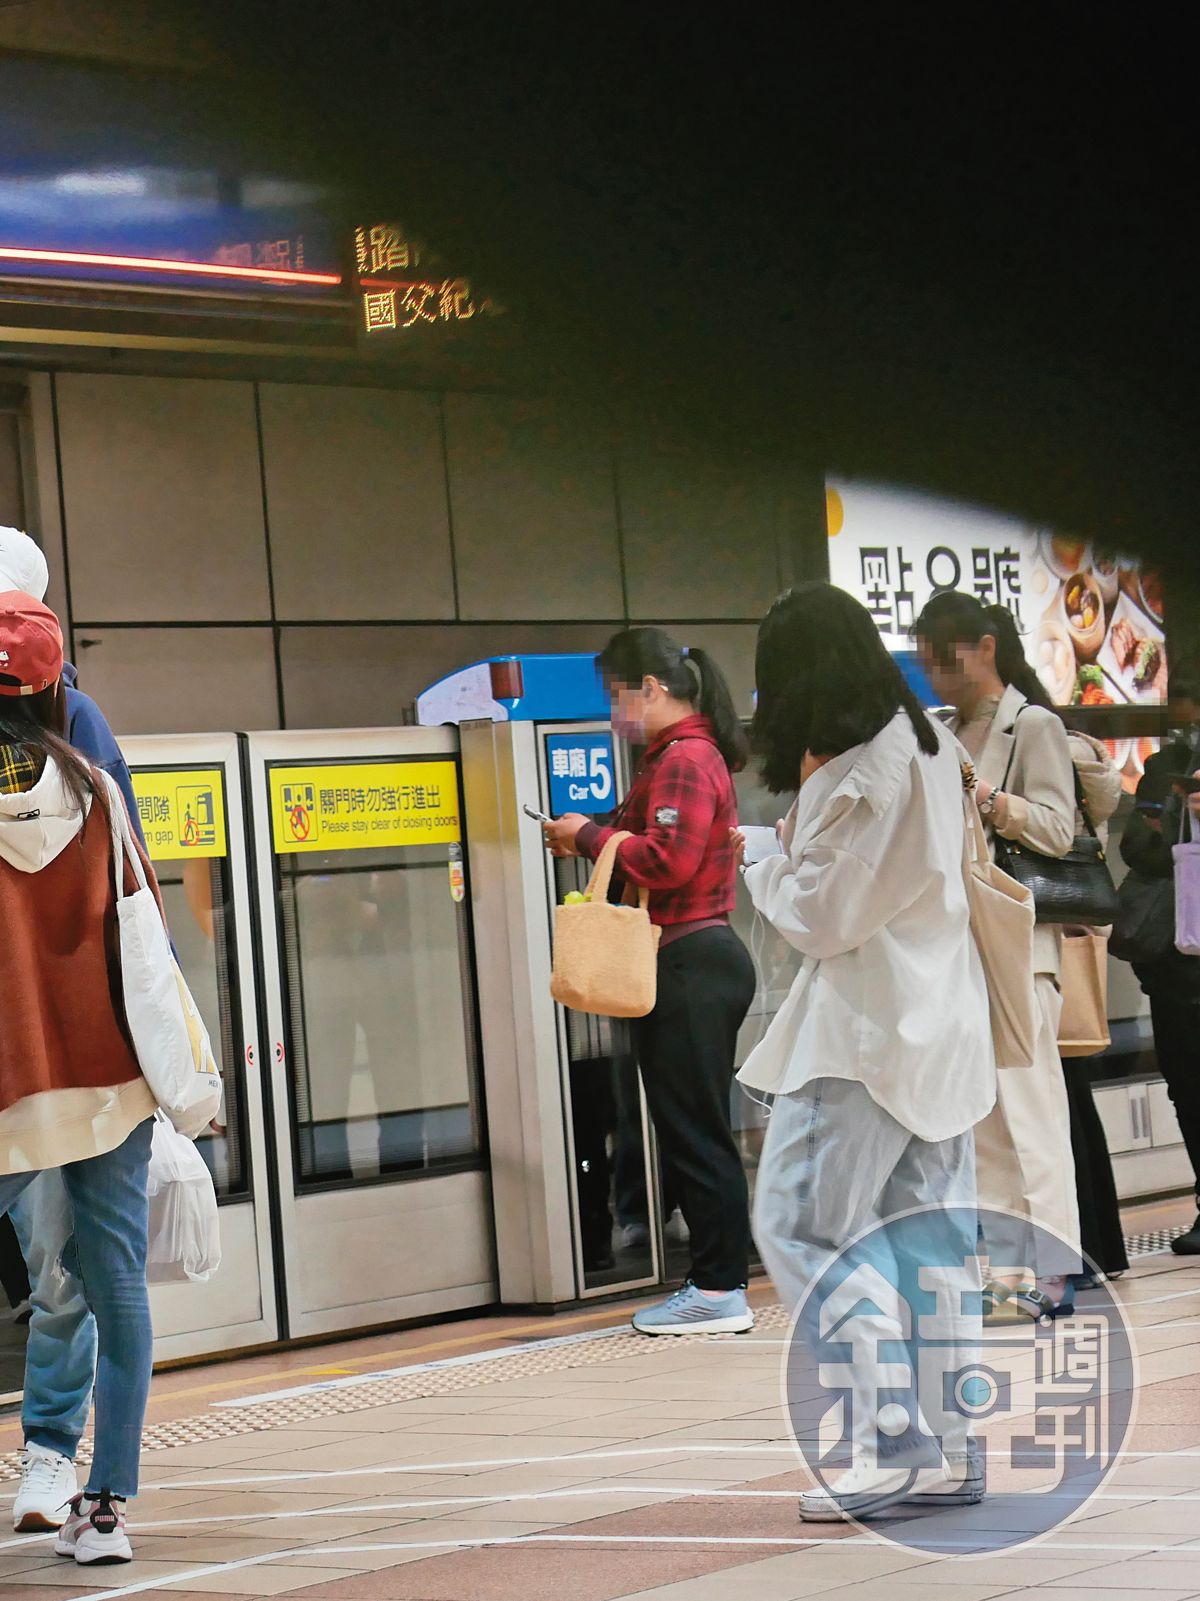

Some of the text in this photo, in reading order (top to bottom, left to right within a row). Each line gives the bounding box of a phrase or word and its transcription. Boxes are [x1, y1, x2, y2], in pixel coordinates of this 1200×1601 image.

[363, 278, 488, 332] 國父紀
[552, 748, 611, 799] 車廂 5
[319, 784, 441, 814] 關門時勿強行進出
[569, 784, 589, 800] Car
[322, 814, 458, 833] Please stay clear of closing doors
[156, 830, 174, 845] gap
[95, 1514, 115, 1523] PUMA
